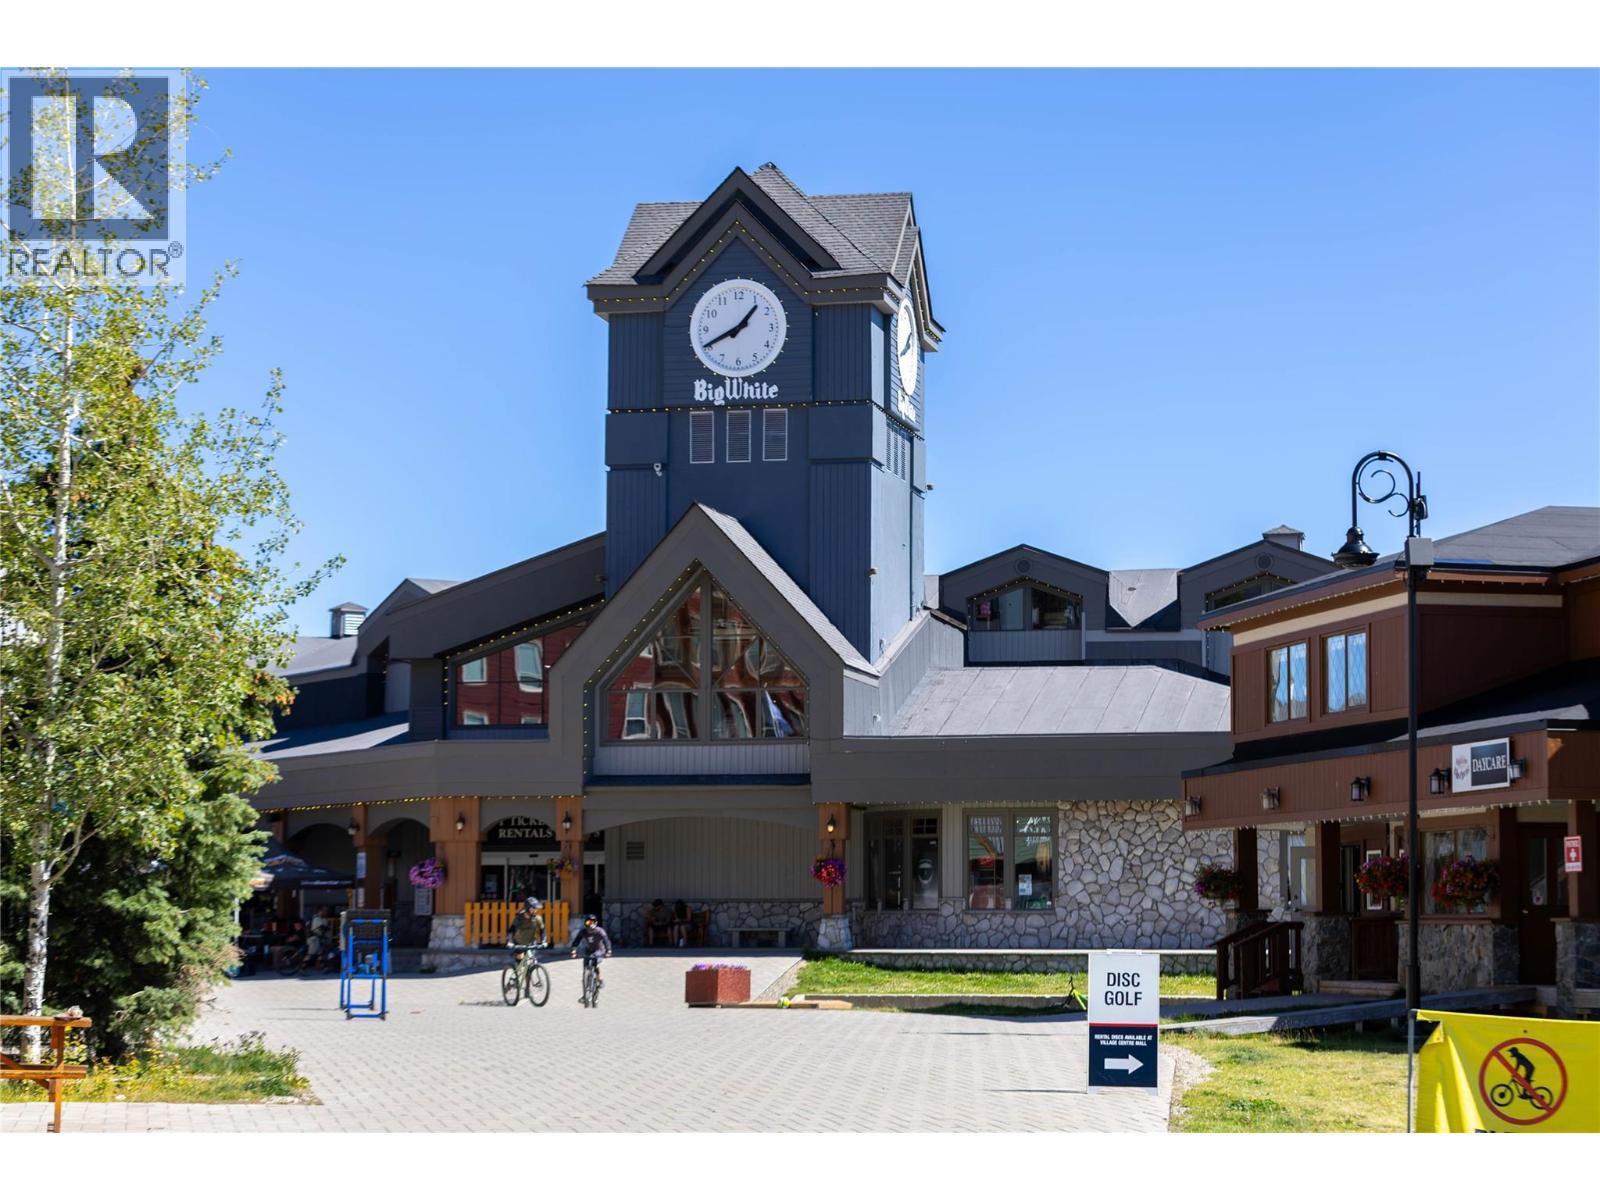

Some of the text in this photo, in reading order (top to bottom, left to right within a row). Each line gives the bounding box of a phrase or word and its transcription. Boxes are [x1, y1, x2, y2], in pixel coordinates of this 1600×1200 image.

[734, 290, 745, 300] 12
[752, 295, 757, 304] 1
[718, 296, 728, 306] 11
[707, 309, 717, 319] 10
[764, 306, 770, 316] 2
[703, 325, 709, 334] 9
[768, 323, 774, 332] 3
[764, 340, 770, 348] 4
[719, 353, 725, 362] 7
[735, 357, 742, 366] 6
[752, 352, 758, 362] 5
[1472, 754, 1506, 772] DAYCARE
[498, 828, 553, 839] RENTALS
[1107, 973, 1140, 987] DISC
[1105, 991, 1142, 1006] GOLF
